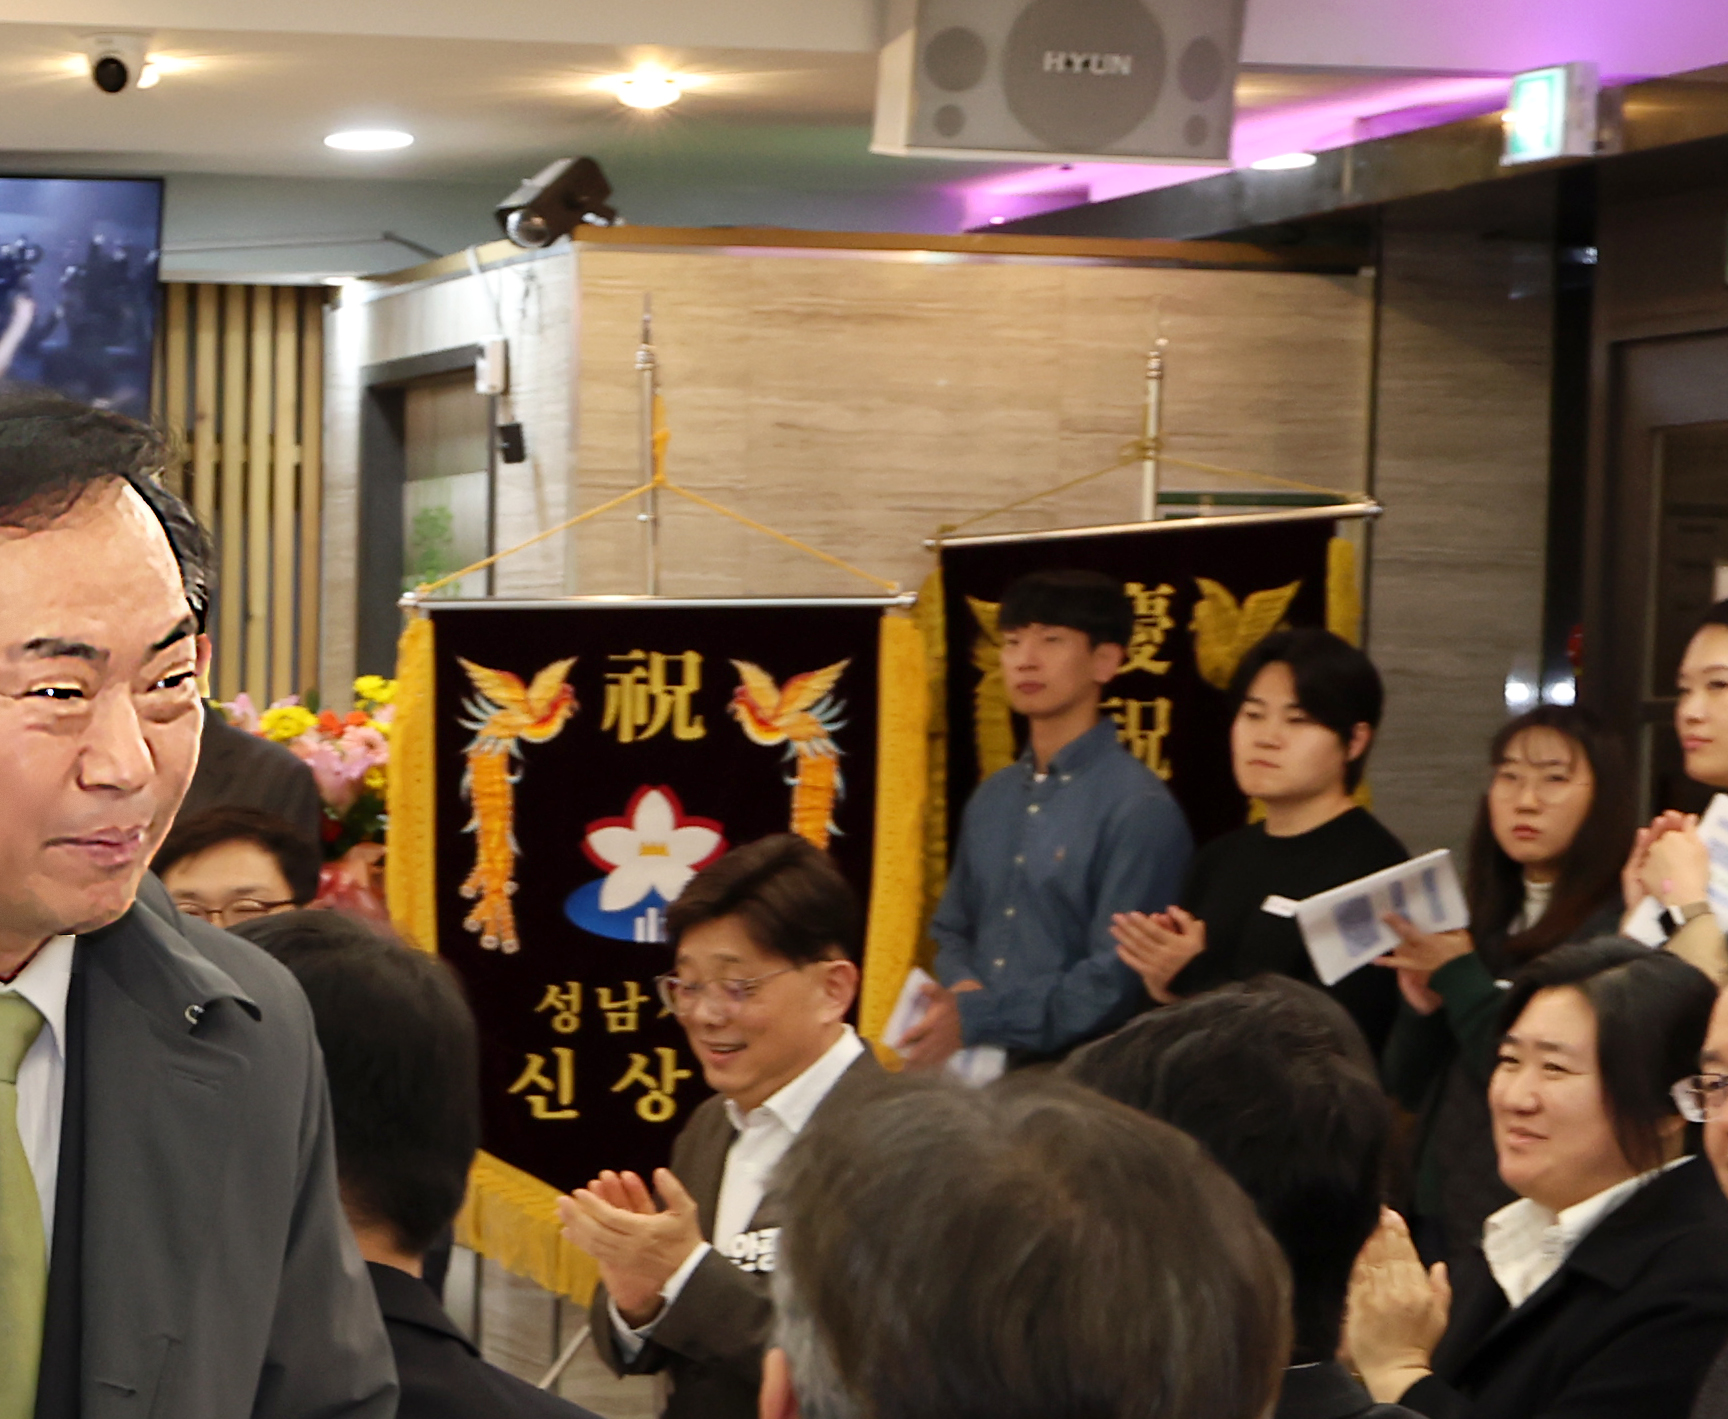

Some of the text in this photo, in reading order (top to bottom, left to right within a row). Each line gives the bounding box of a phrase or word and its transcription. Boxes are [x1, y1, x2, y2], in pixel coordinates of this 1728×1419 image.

[1042, 50, 1132, 76] HYUN
[600, 648, 707, 744] 祝
[533, 979, 674, 1035] 성남
